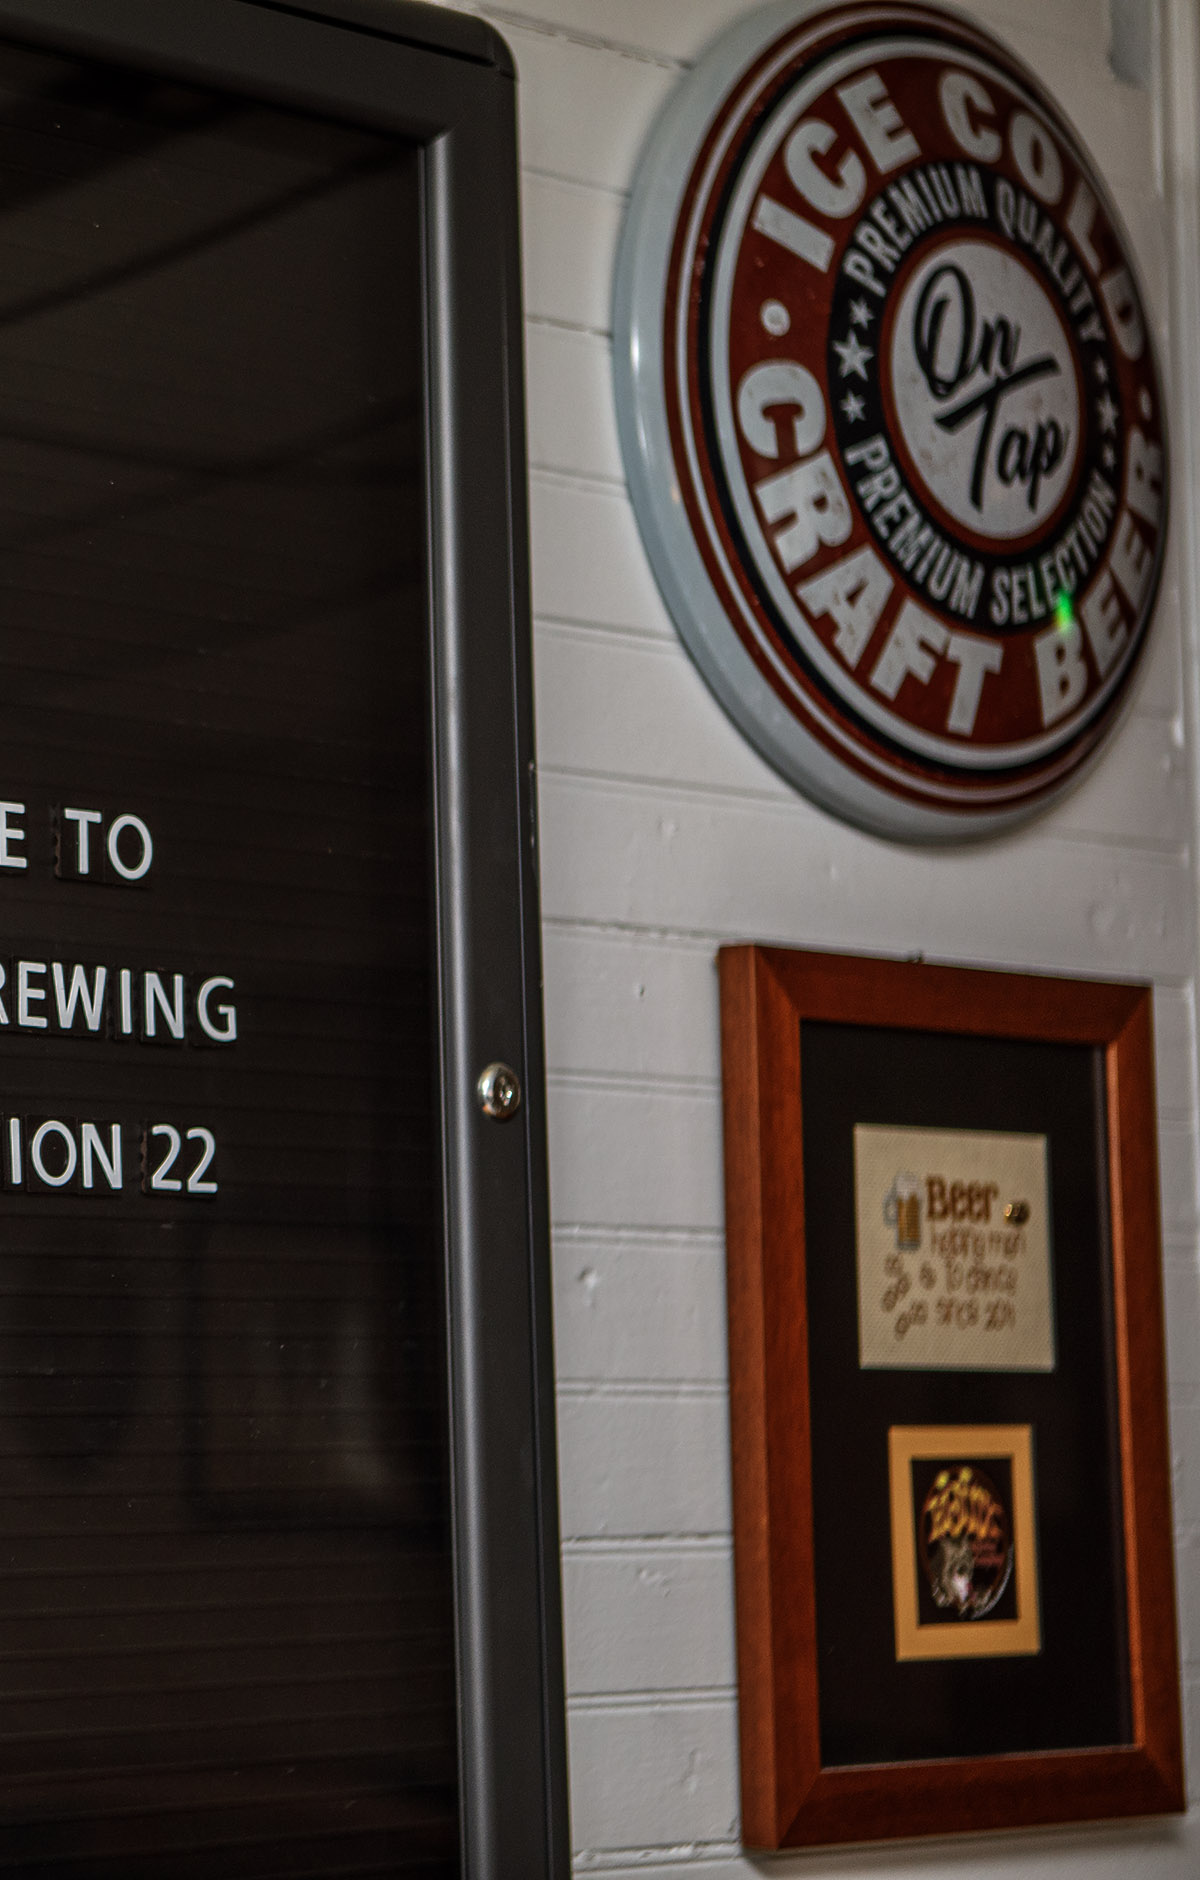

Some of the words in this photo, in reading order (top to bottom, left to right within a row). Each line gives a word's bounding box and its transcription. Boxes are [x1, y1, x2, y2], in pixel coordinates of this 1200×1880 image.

[753, 70, 922, 274] ICE
[940, 67, 1144, 361] COLD
[844, 163, 988, 297] PREMIUM
[997, 178, 1107, 342] QUALITY
[914, 264, 1021, 398] On
[934, 354, 1071, 512] Tap
[738, 359, 1003, 736] CRAFT
[1033, 426, 1162, 729] BEER
[845, 434, 984, 619] PREMIUM
[990, 467, 1117, 625] SELECTION
[64, 807, 153, 880] TO
[150, 1124, 219, 1193] 22
[926, 1174, 999, 1224] Beer
